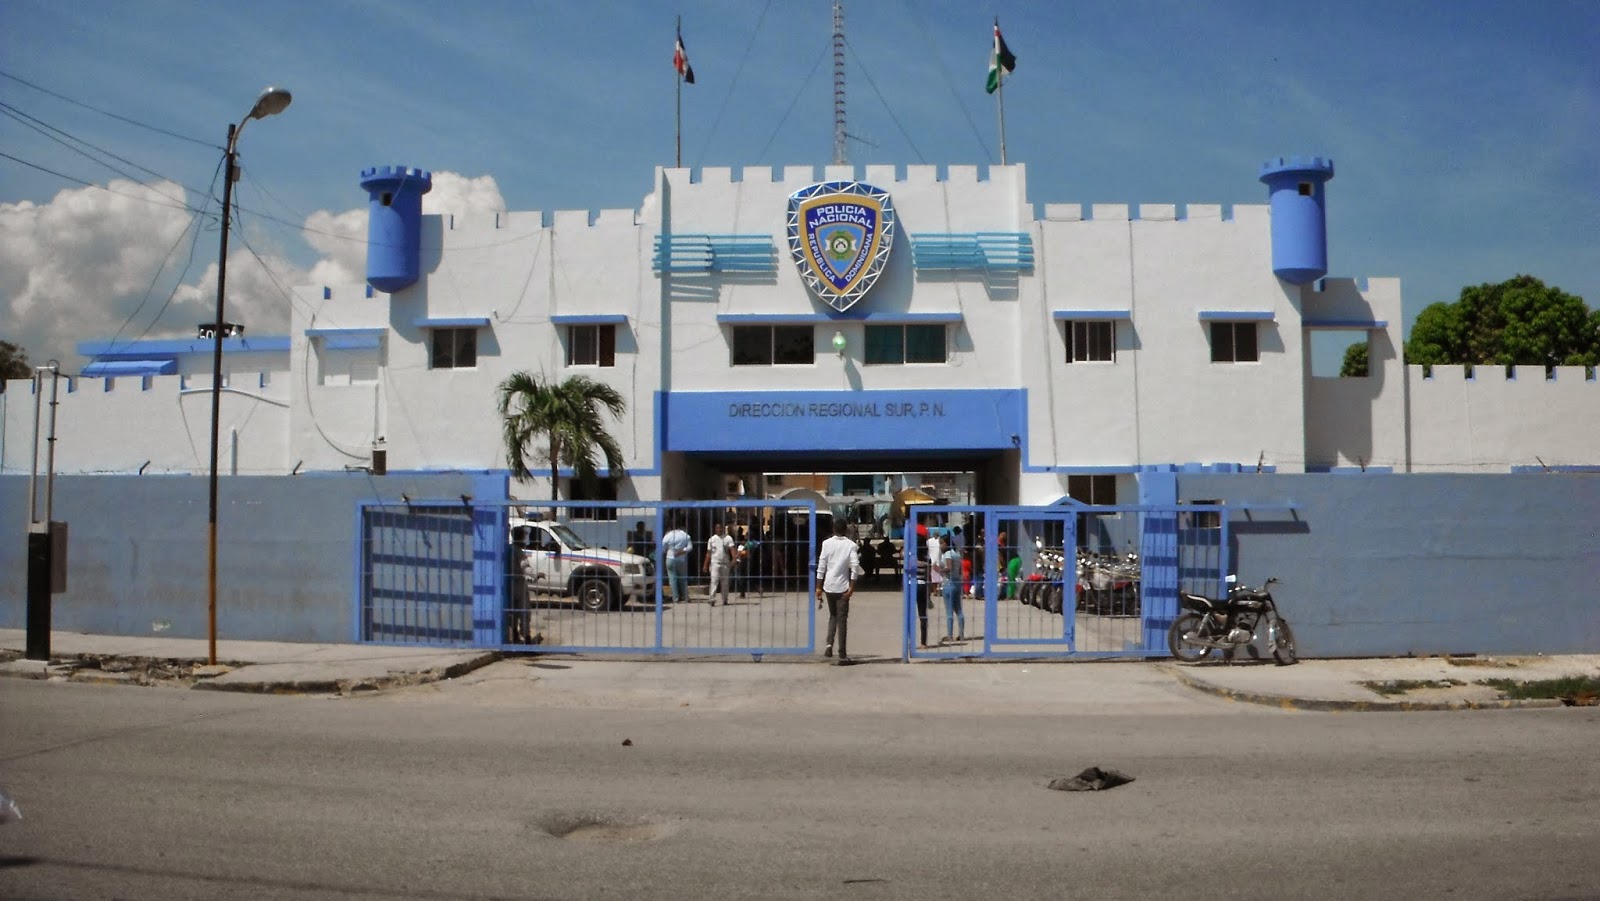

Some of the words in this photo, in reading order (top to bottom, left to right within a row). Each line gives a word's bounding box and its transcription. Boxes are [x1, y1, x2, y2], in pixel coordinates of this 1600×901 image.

[816, 205, 867, 216] POLICIA
[809, 213, 873, 229] NACIONAL
[808, 232, 835, 282] REPUBLICA
[844, 232, 873, 282] DOMINICANA
[808, 402, 881, 418] REGIONAL
